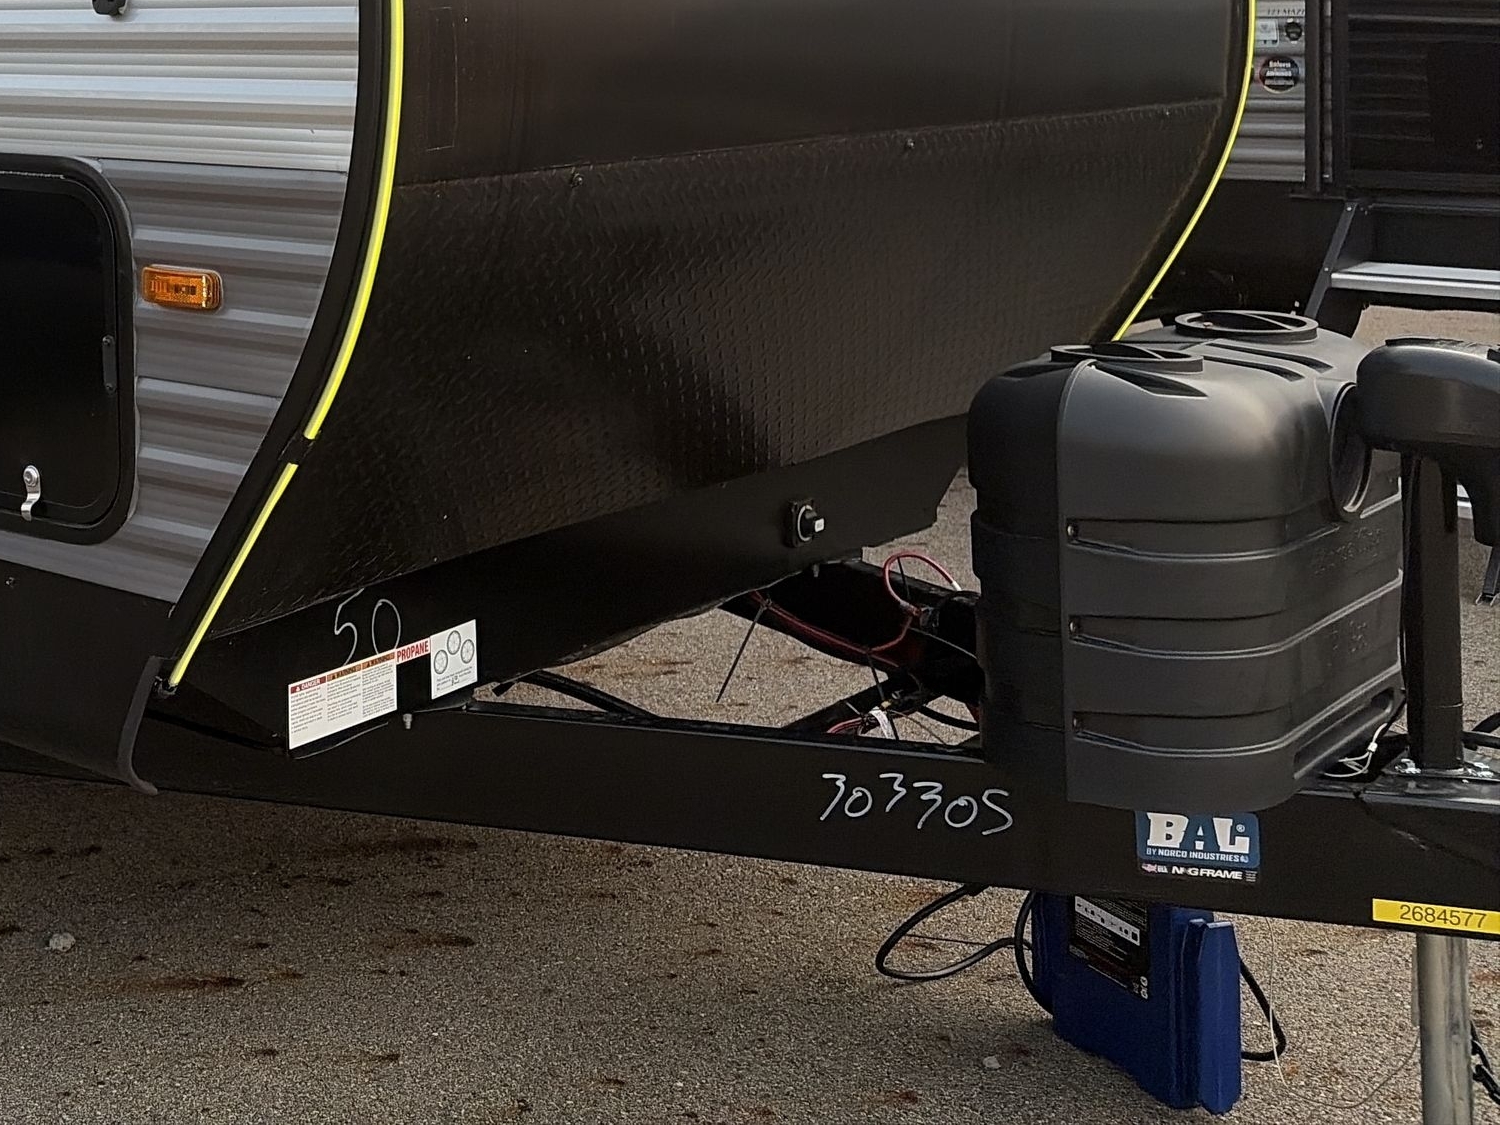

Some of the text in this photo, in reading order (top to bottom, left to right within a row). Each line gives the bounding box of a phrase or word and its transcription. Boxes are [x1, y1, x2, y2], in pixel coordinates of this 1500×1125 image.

[333, 587, 402, 666] 50
[396, 640, 430, 663] PROPANE
[1146, 848, 1240, 863] BY NORCO INDUSTRIES
[1200, 867, 1243, 880] FRAME
[1399, 904, 1488, 929] 2684577
